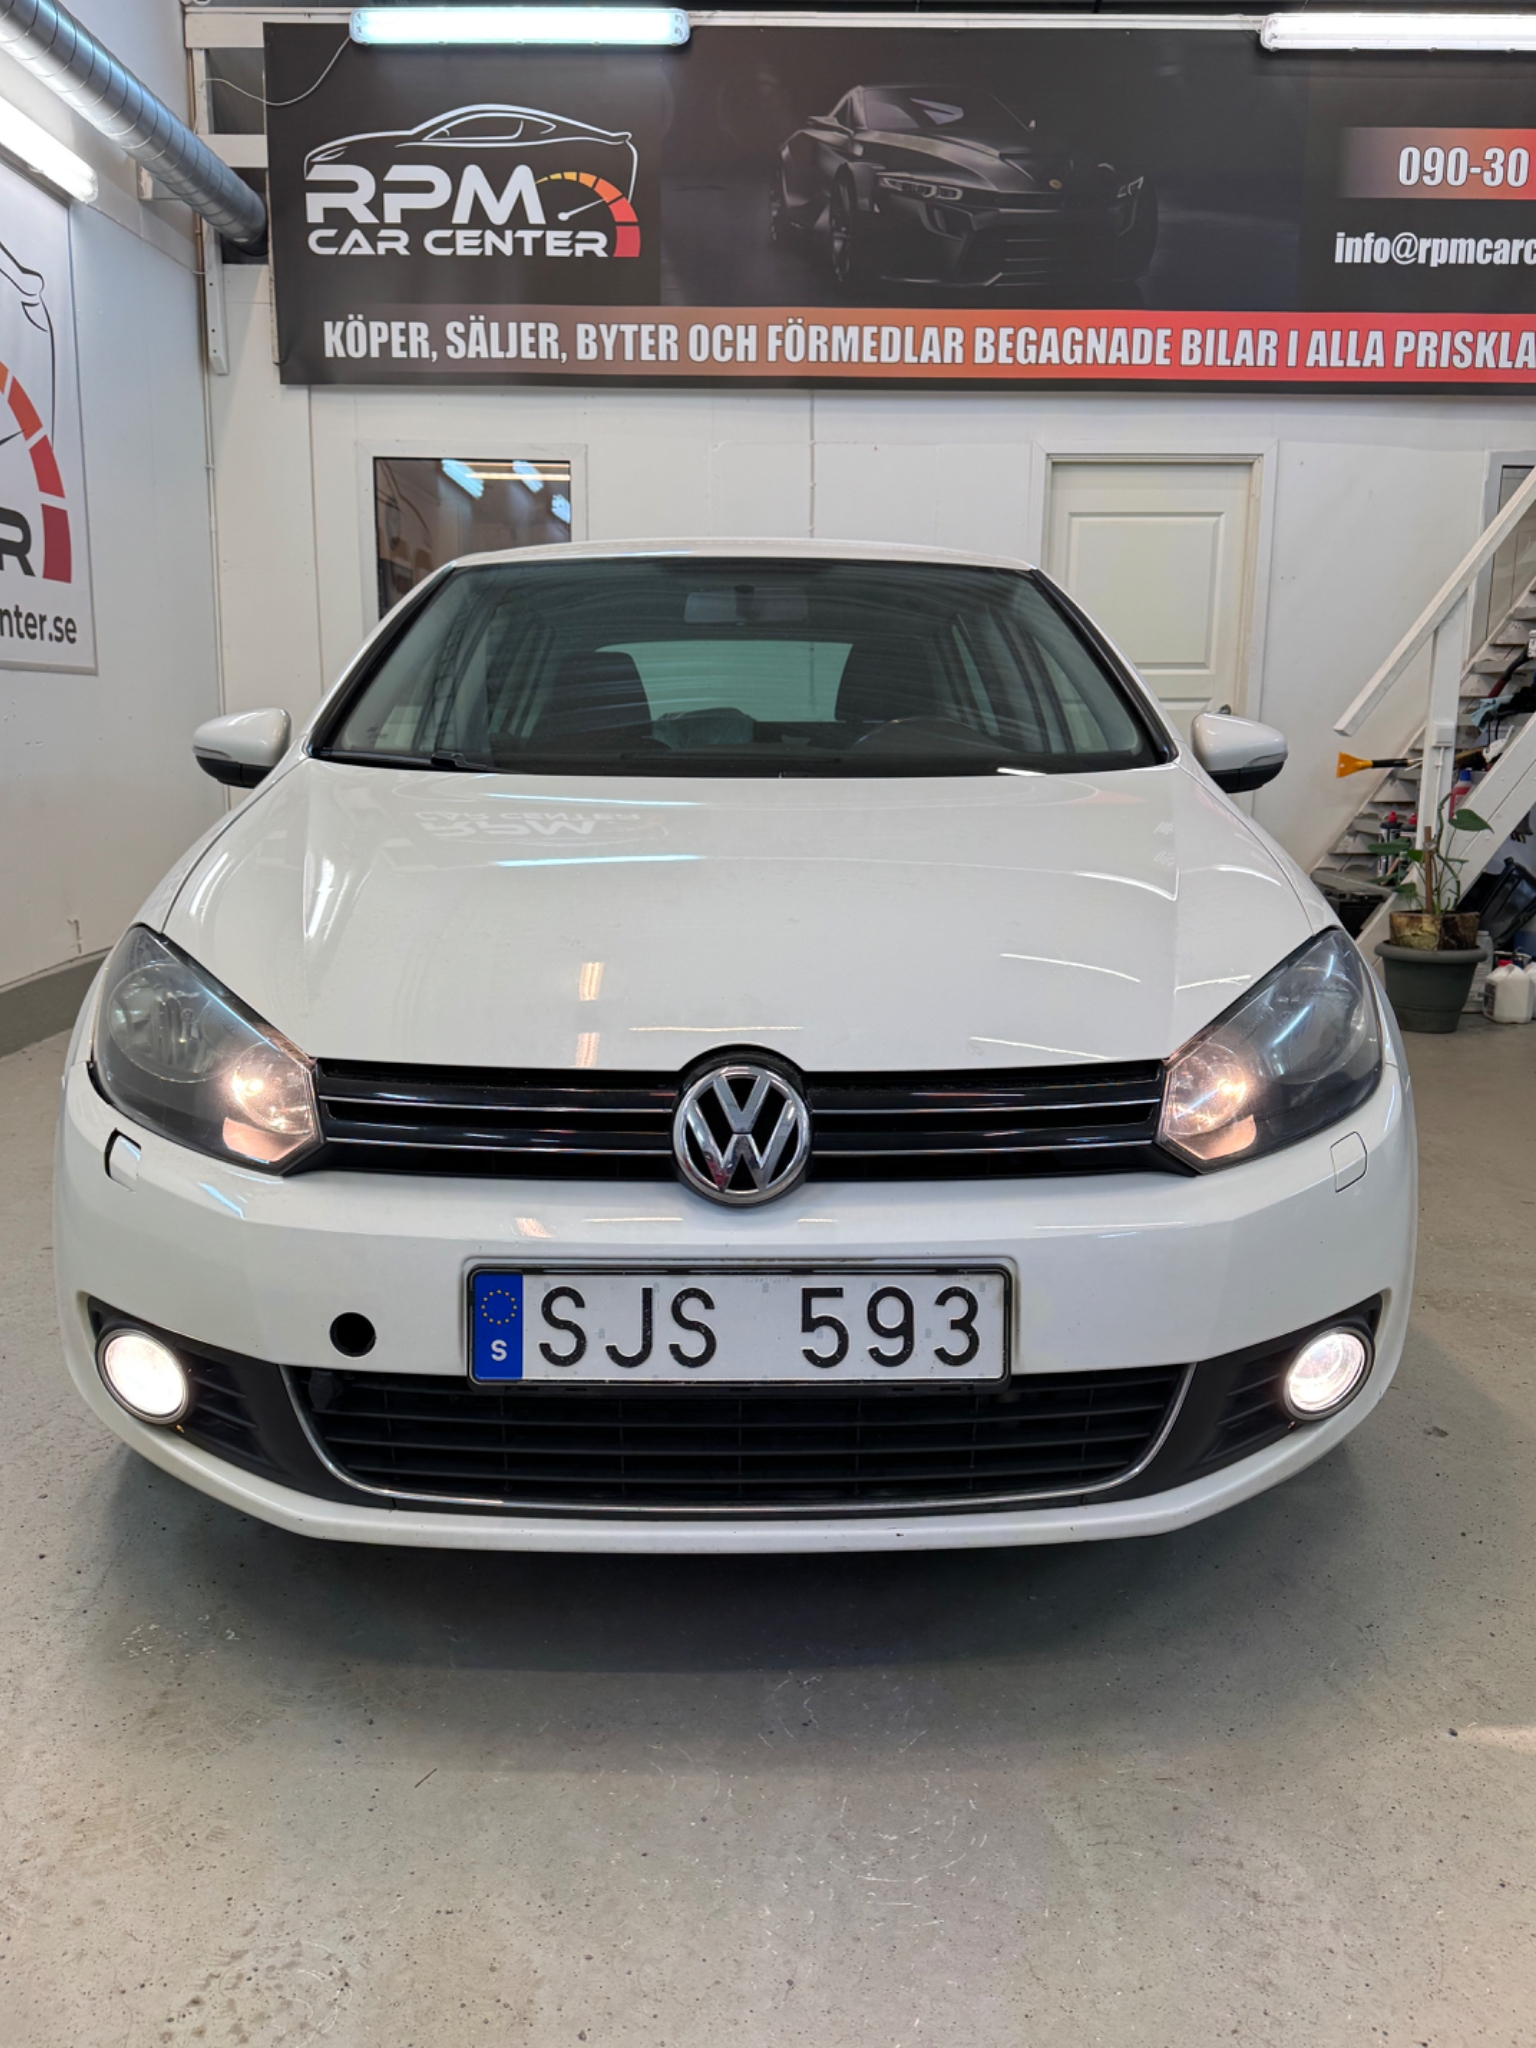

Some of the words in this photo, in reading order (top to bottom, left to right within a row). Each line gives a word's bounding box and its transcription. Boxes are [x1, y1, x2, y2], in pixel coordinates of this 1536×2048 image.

[1398, 146, 1529, 187] 090-30
[305, 164, 546, 225] RPM
[308, 229, 410, 256] CAR
[423, 229, 608, 258] CENTER
[324, 314, 438, 362] KÖPER,
[445, 314, 567, 364] SÄLJER,
[576, 322, 679, 361] BYTER
[688, 322, 758, 362] OCH
[767, 317, 965, 364] FÖRMEDLAR
[973, 325, 1172, 366] BEGAGNADE
[1180, 328, 1279, 367] BILAR
[1287, 330, 1299, 367] I
[1305, 330, 1385, 368] ALLA
[1393, 330, 1536, 369] PRISKLA
[490, 1339, 508, 1361] S
[538, 1286, 717, 1368] SJS
[801, 1285, 980, 1369] 593
